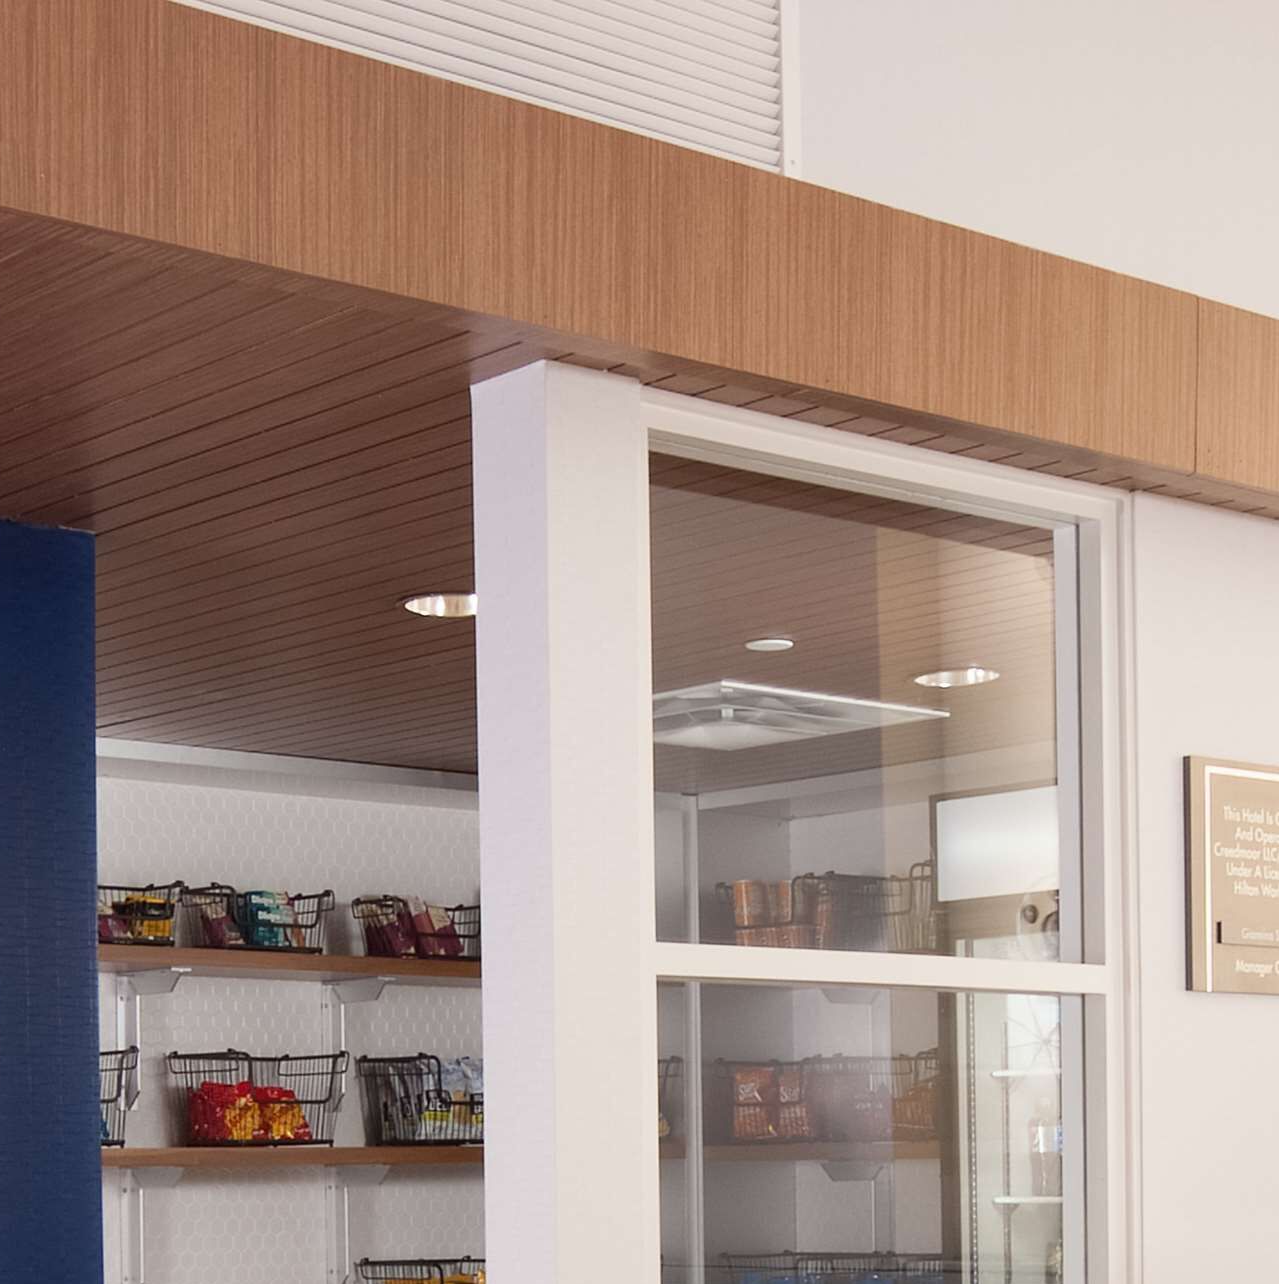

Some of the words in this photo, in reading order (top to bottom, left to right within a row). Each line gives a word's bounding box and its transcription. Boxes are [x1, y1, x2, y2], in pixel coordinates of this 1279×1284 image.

[1223, 805, 1241, 821] This
[1242, 807, 1265, 823] Hotel
[1266, 811, 1274, 825] Is
[1235, 826, 1254, 841] And
[1226, 861, 1252, 877] Under
[1254, 865, 1262, 878] A
[1233, 880, 1260, 896] Hilton
[1234, 960, 1273, 978] Manager
